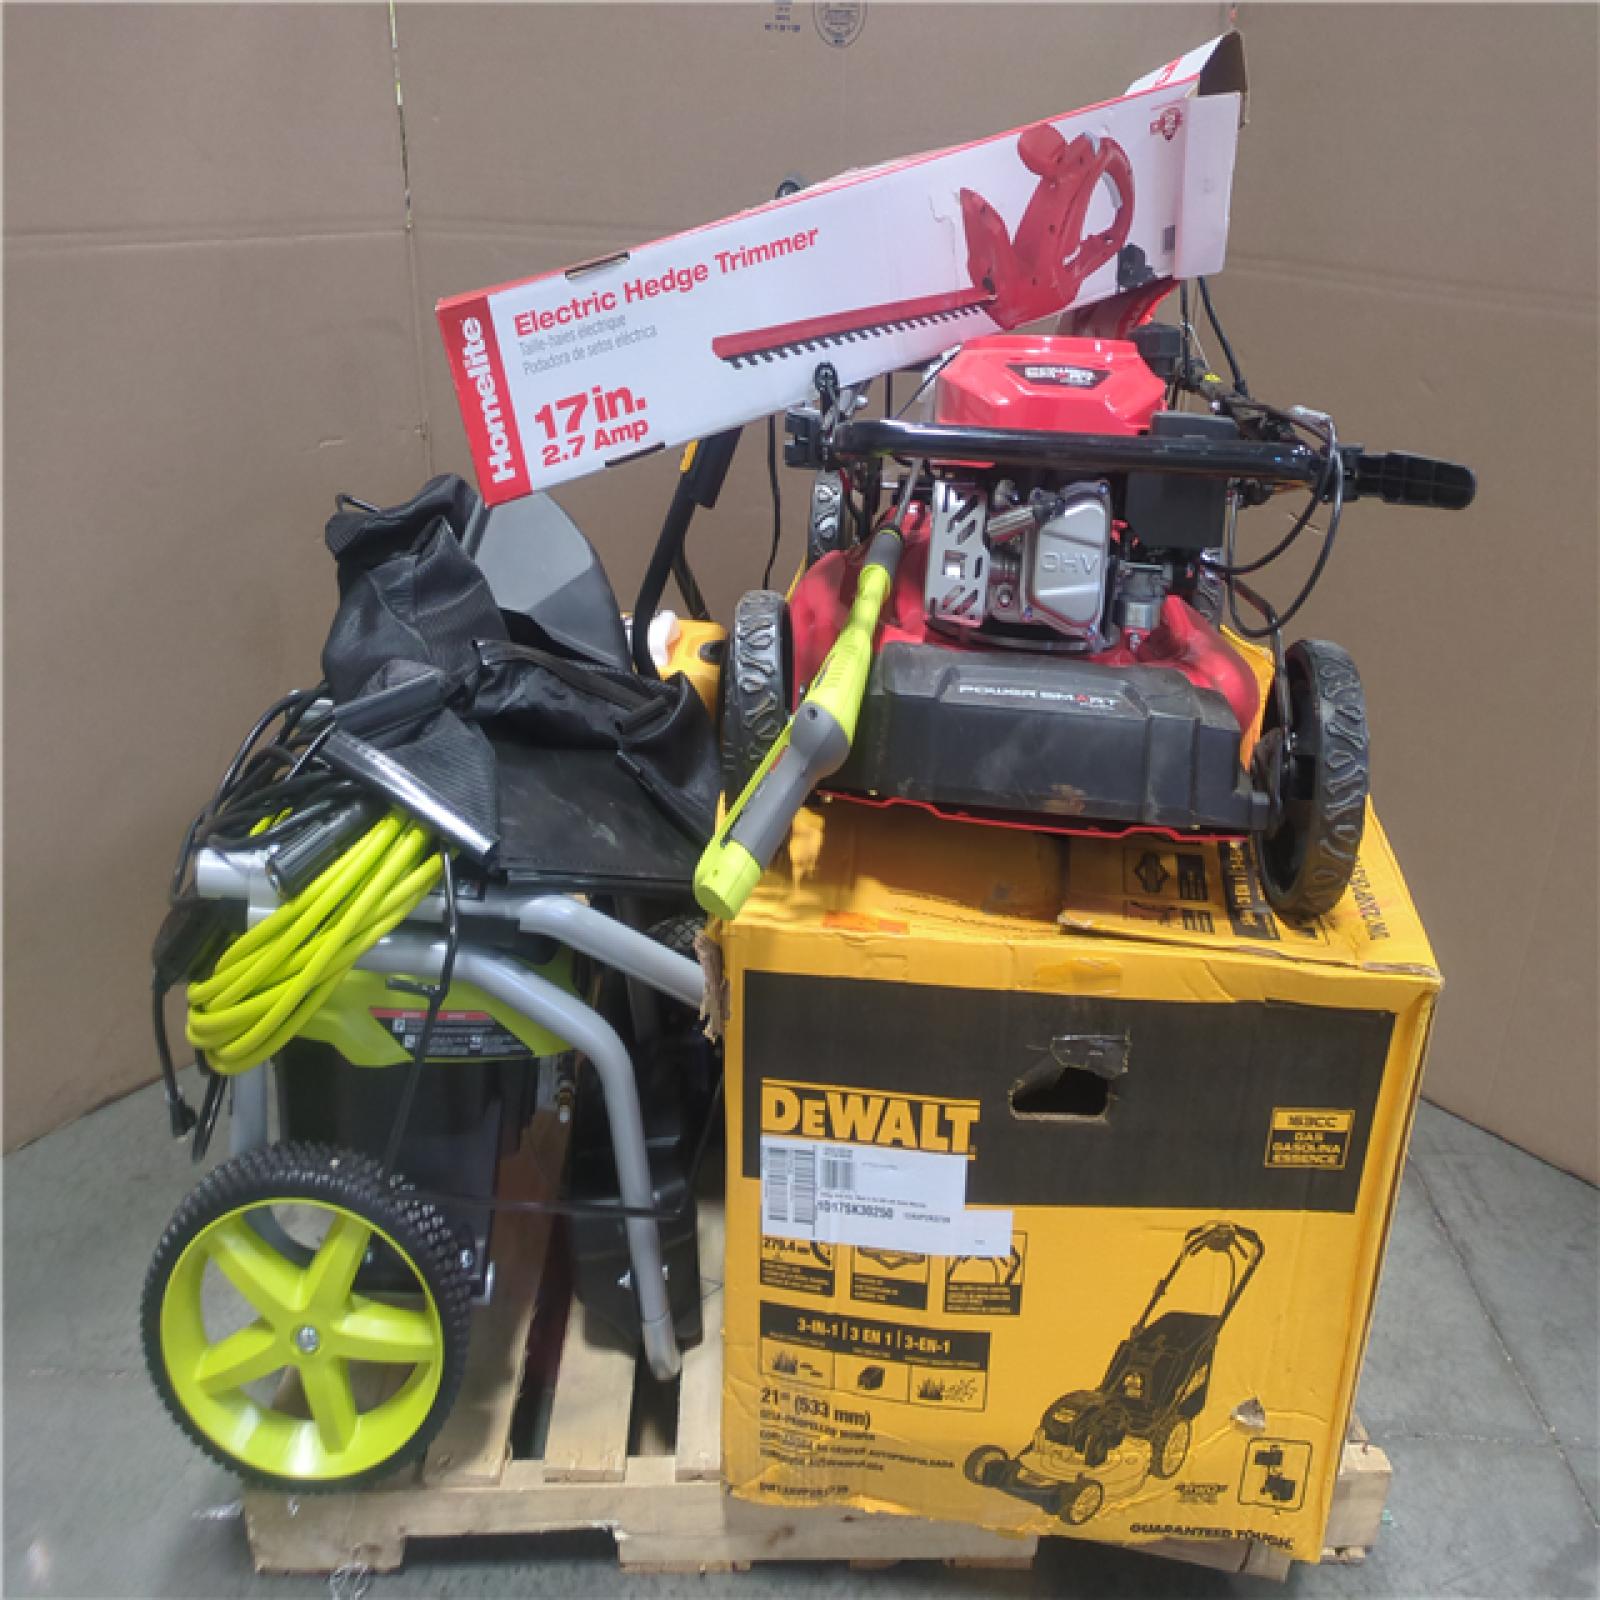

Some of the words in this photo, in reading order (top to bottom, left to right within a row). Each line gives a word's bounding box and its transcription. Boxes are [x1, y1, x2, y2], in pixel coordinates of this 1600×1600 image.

[513, 291, 618, 337] Electric
[623, 262, 709, 304] Hedge
[714, 226, 820, 274] Trimmer
[459, 316, 516, 484] Homelite
[534, 391, 589, 440] 17
[591, 384, 648, 423] in.
[541, 434, 586, 468] 2.7
[594, 419, 649, 450] Amp
